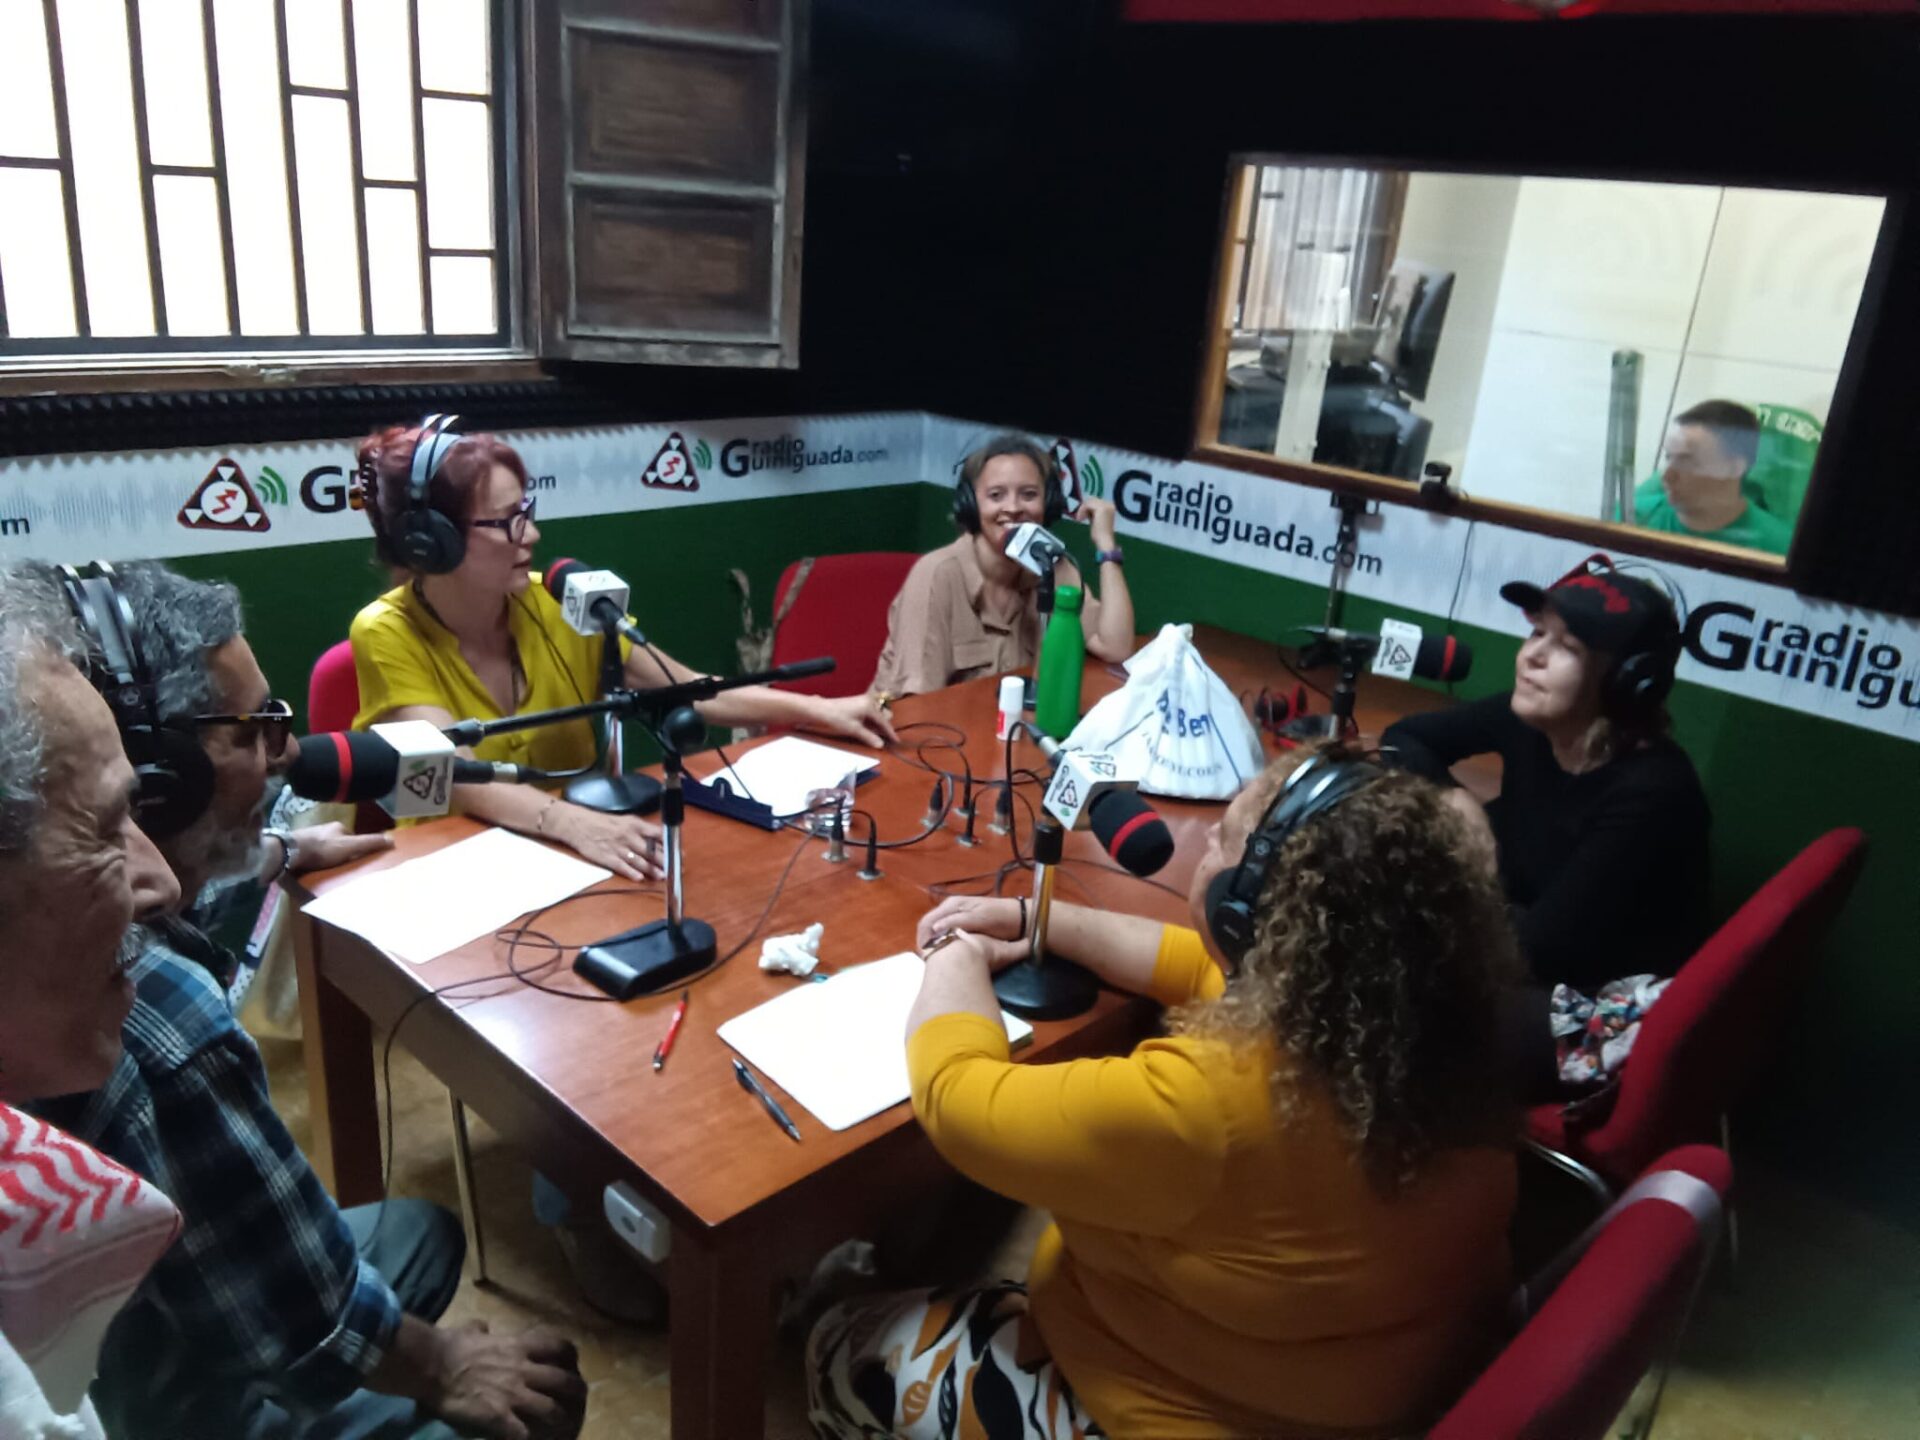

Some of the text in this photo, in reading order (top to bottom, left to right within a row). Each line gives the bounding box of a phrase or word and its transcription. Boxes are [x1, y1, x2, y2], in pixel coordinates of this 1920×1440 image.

[752, 433, 804, 452] radio
[1156, 480, 1233, 515] radio
[1759, 619, 1902, 671] radio
